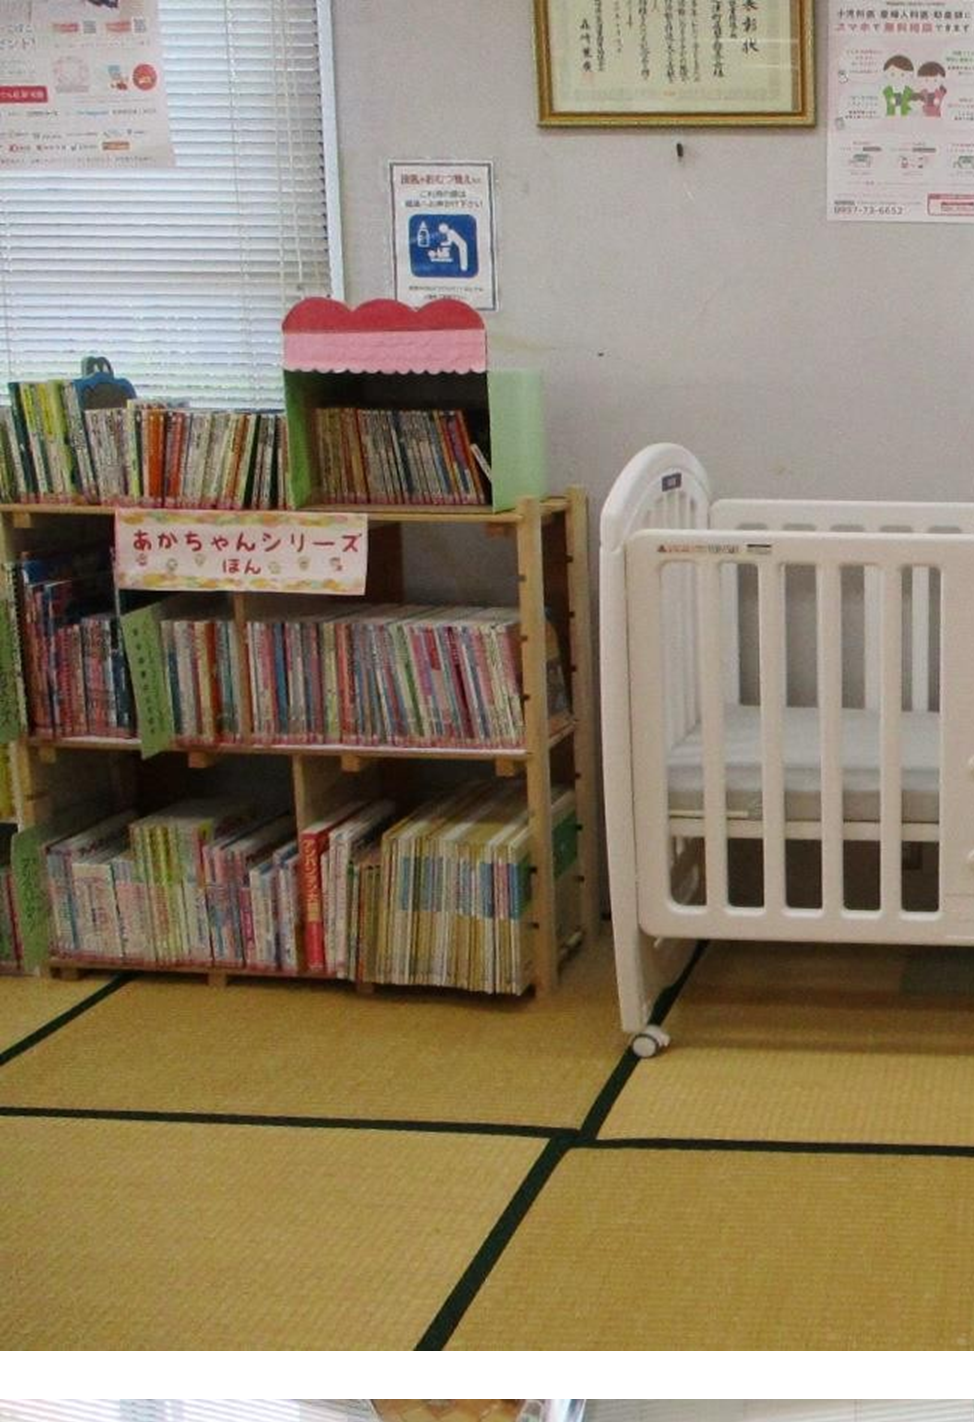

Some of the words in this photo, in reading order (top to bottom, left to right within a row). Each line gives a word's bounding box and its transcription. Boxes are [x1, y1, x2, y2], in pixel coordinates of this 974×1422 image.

[132, 529, 363, 553] あかちゃんシリーズ
[222, 558, 262, 576] ほん
